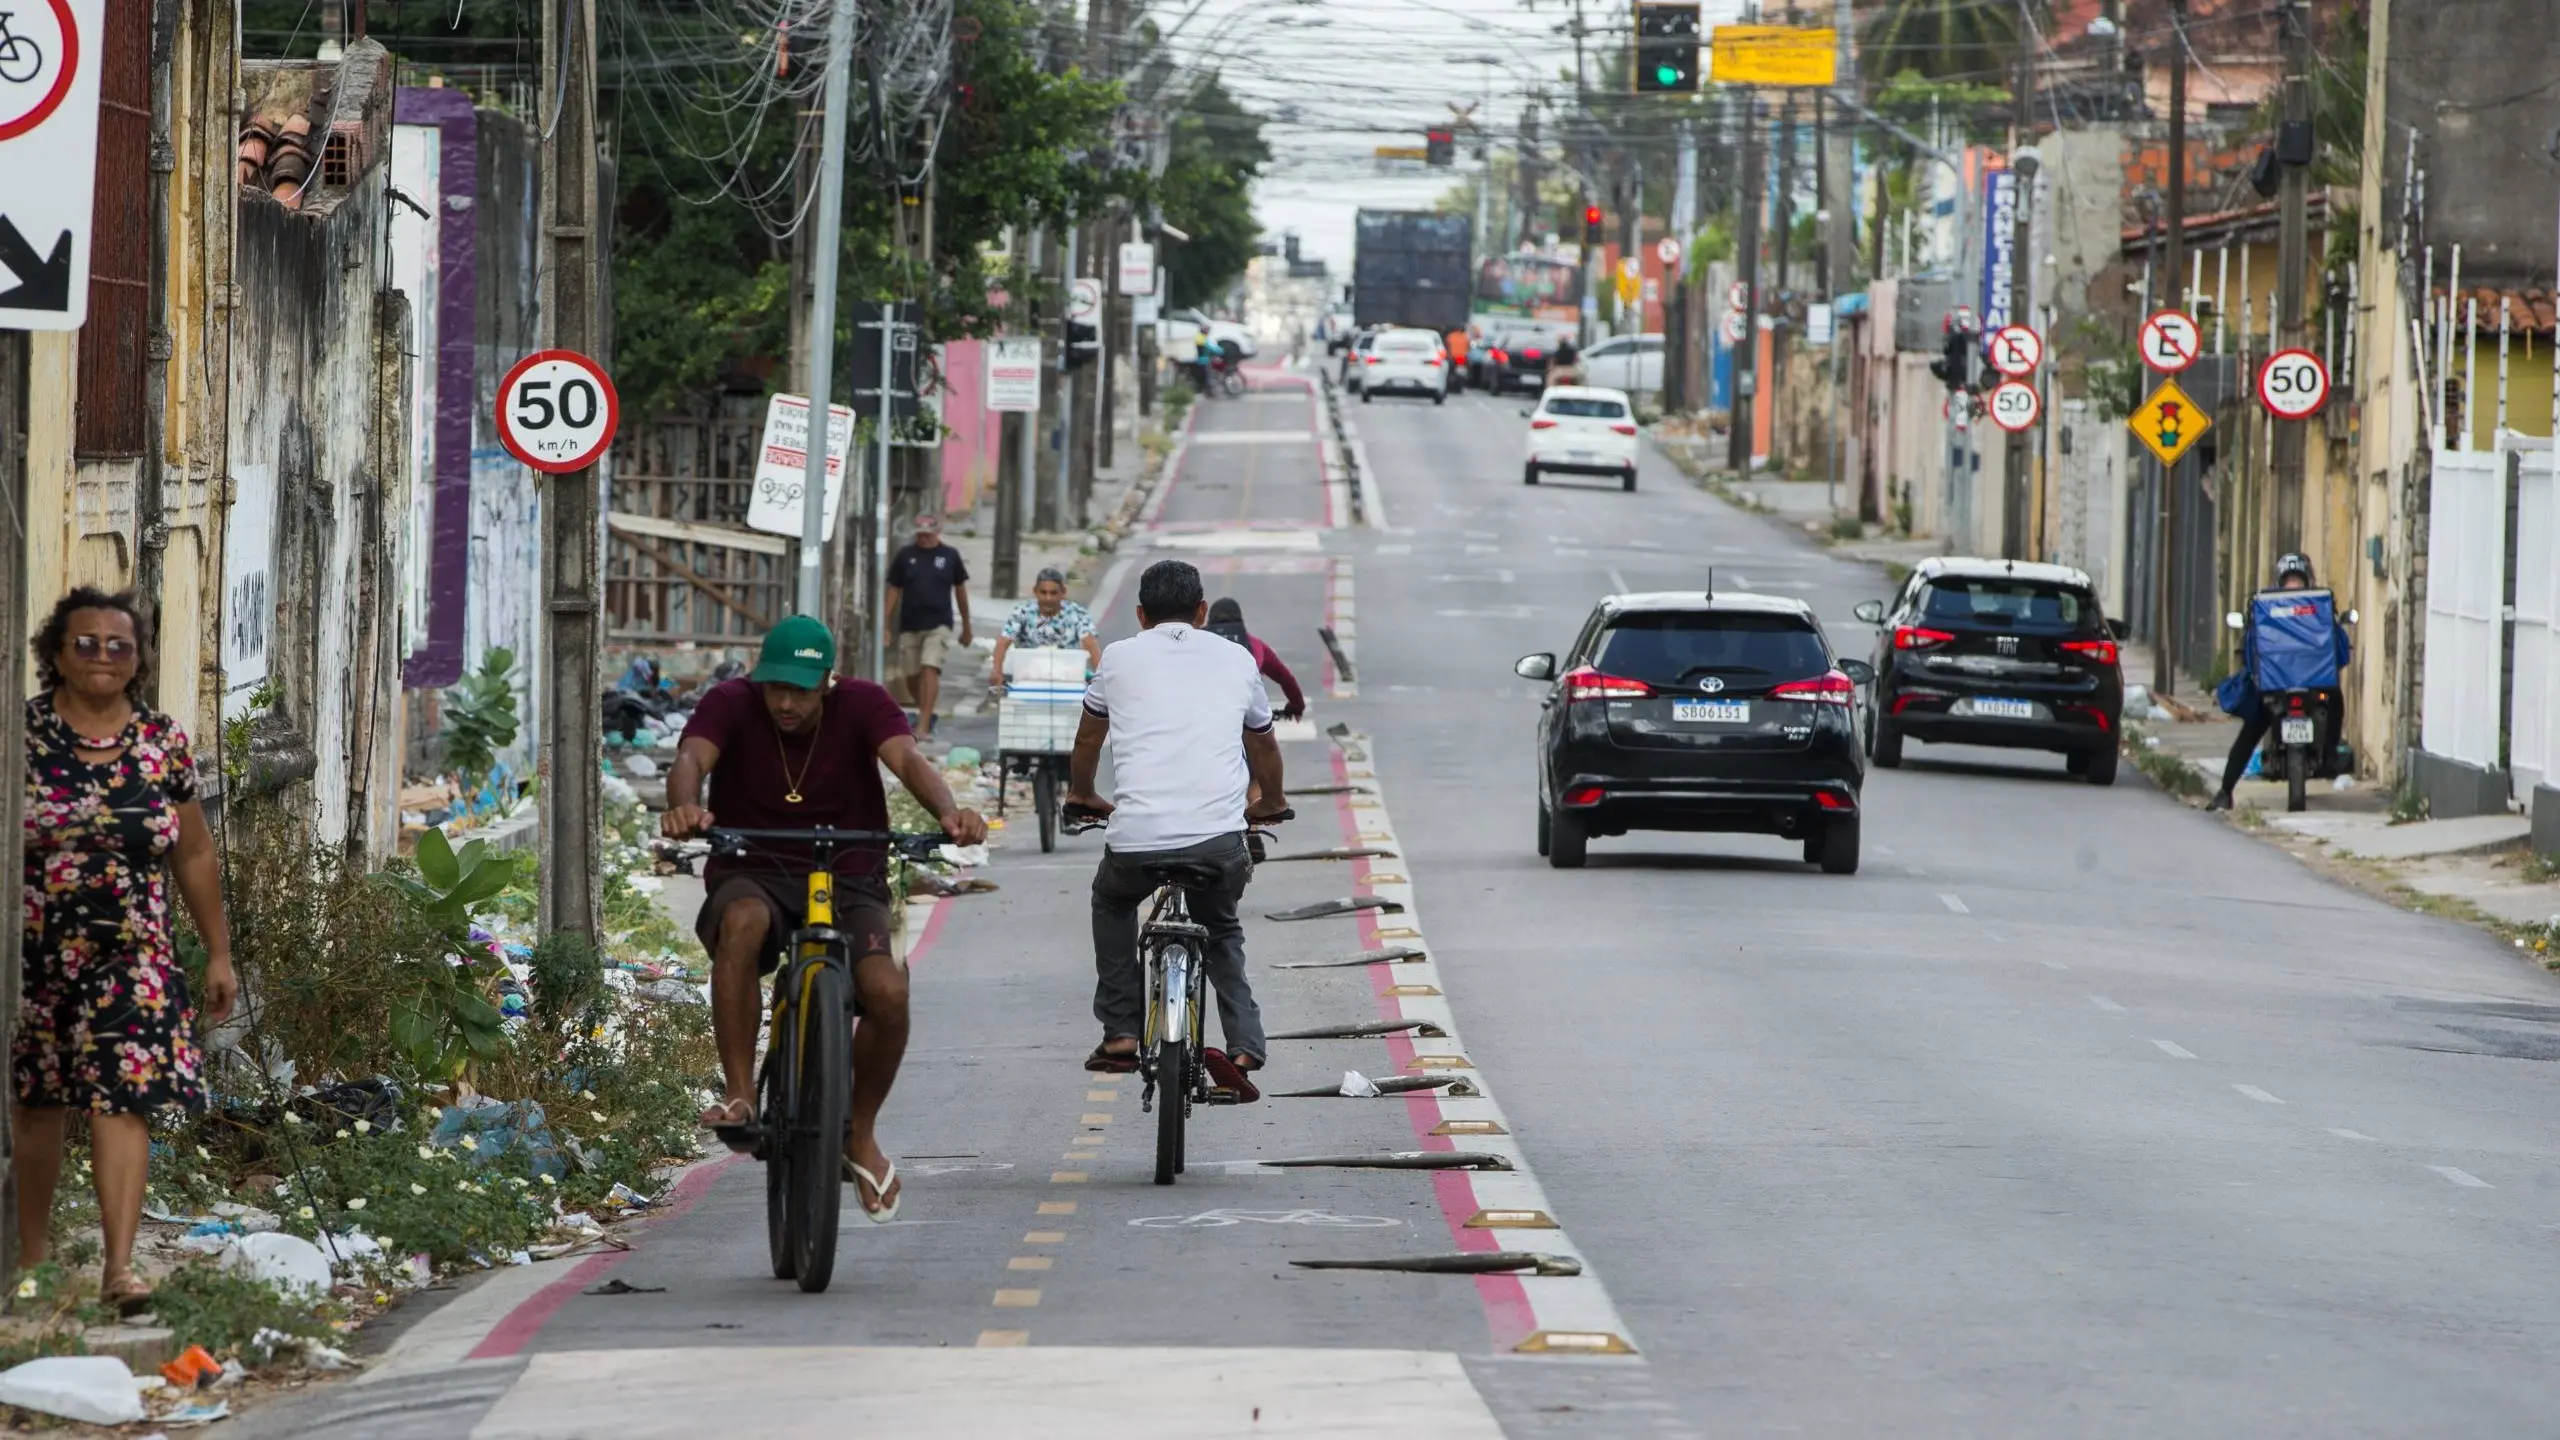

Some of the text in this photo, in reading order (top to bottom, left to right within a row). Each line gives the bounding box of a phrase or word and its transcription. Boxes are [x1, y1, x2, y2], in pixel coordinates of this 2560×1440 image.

[2007, 337, 2025, 363] E
[2159, 324, 2181, 357] E
[2271, 365, 2317, 393] 50
[517, 379, 597, 430] 50
[1998, 392, 2032, 413] 50
[538, 439, 578, 451] km/h
